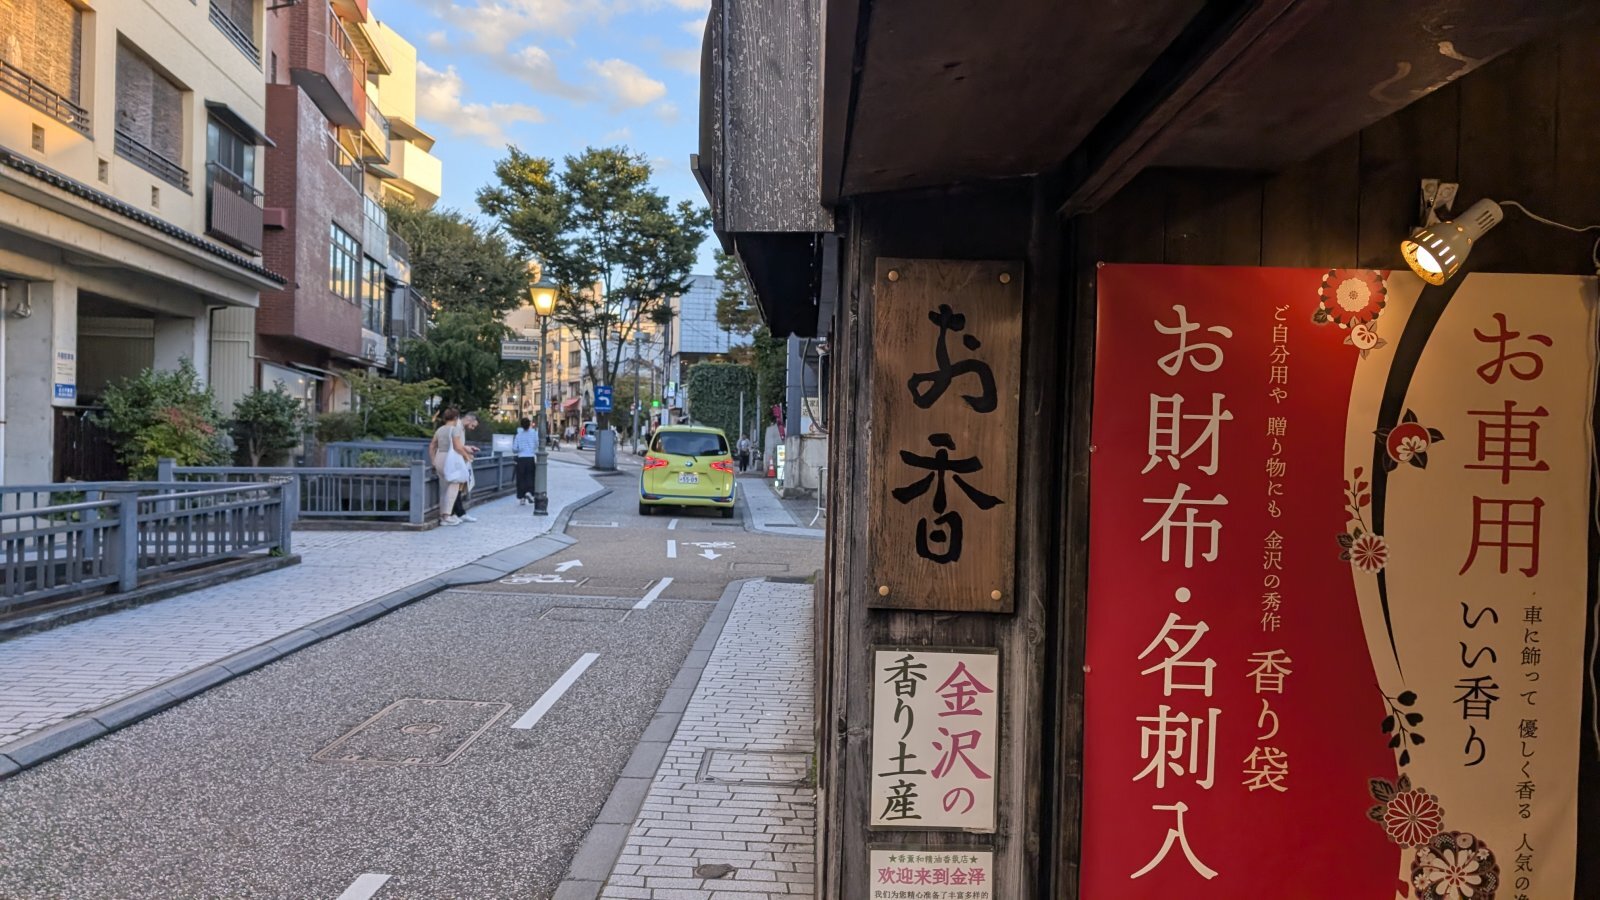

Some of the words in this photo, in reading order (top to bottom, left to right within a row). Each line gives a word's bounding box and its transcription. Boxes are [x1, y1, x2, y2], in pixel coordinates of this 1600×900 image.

[1269, 304, 1291, 404] ご自分用や
[892, 304, 1005, 564] お香
[1264, 417, 1287, 519] 贈り物にも
[1458, 312, 1553, 578] お車用
[1129, 304, 1234, 881] お財布・名刺入
[1260, 530, 1284, 632] 金沢の秀作
[1242, 648, 1293, 793] 香り袋
[1452, 601, 1500, 768] いい香り
[1520, 605, 1542, 705] 車に飾って
[878, 654, 928, 820] 香り土産
[931, 661, 994, 814] 金沢の
[1515, 718, 1538, 819] 優しく香る
[878, 866, 986, 886] 欢迎来到金泽
